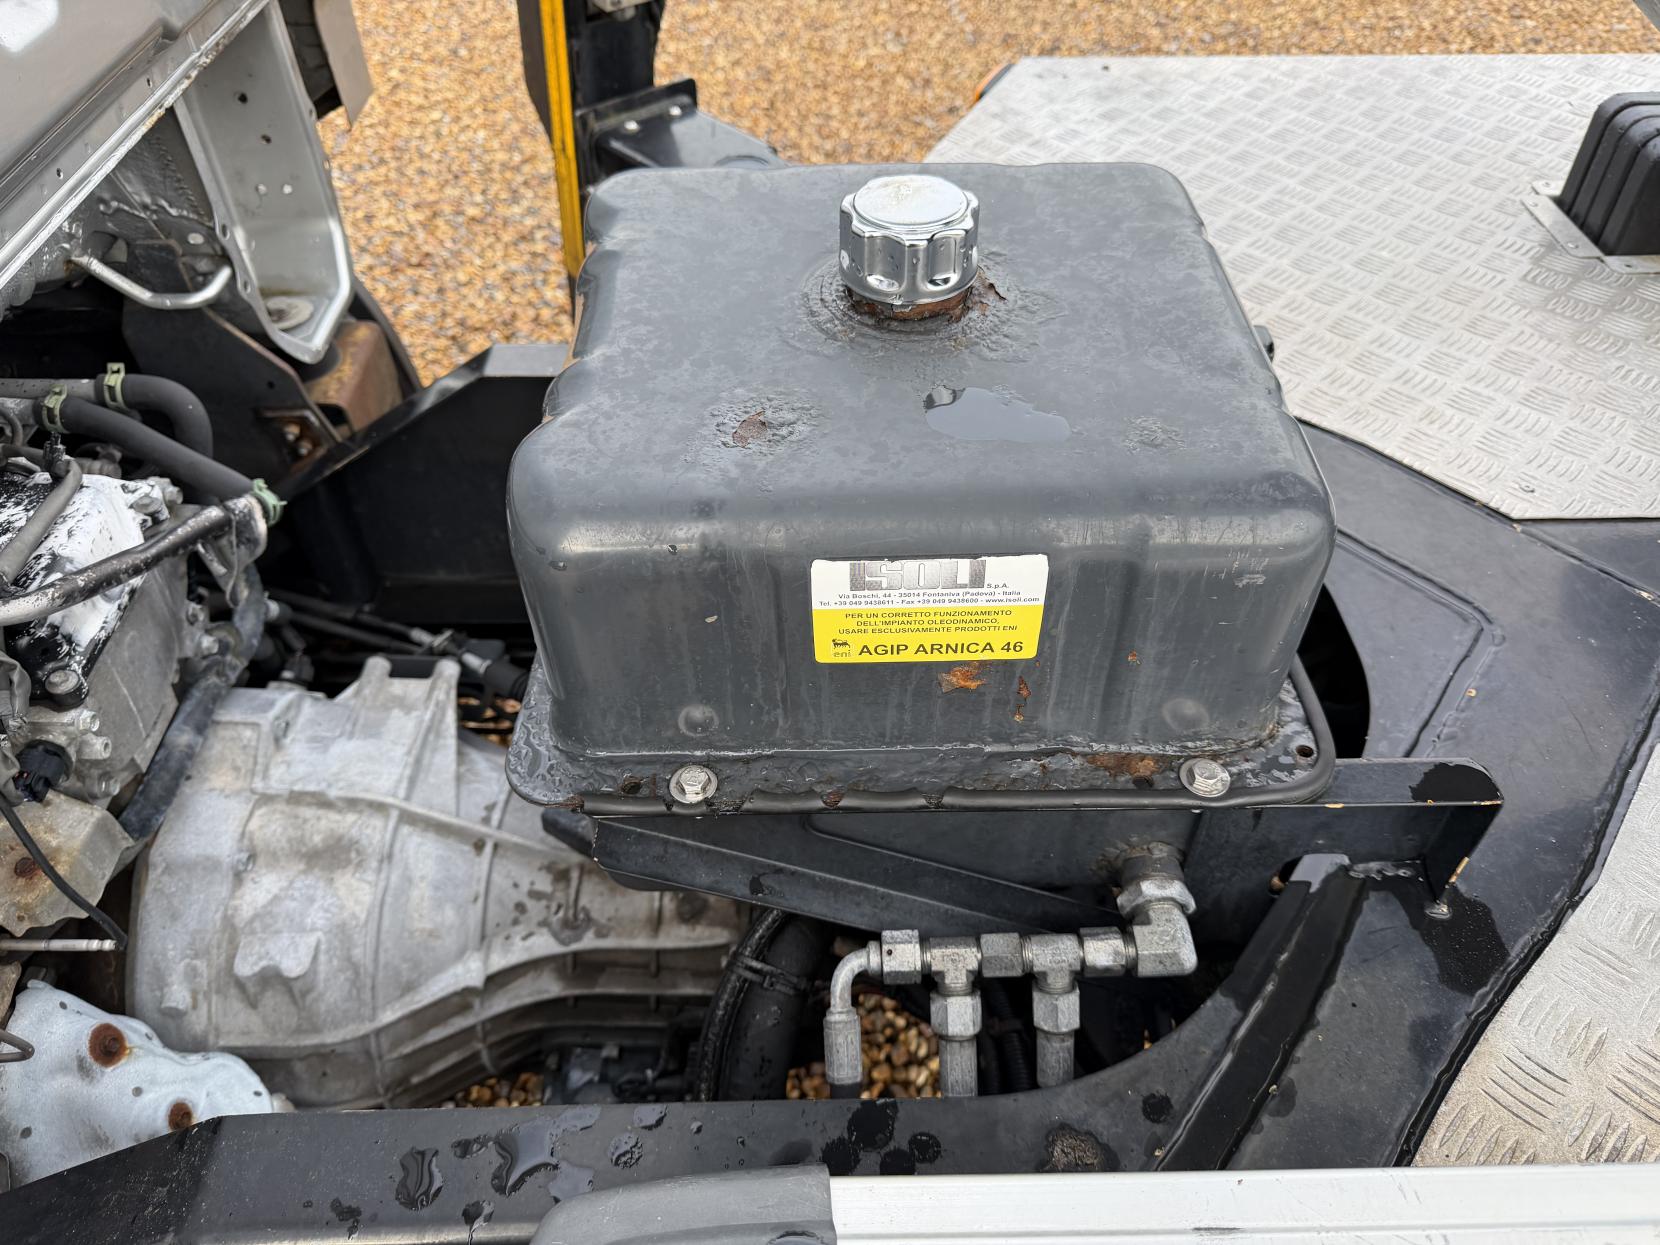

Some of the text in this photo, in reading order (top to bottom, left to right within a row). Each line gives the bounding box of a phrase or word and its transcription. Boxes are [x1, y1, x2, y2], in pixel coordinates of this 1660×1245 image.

[850, 560, 986, 591] ISOLI
[858, 641, 1023, 656] AGIP ARNICA 46
